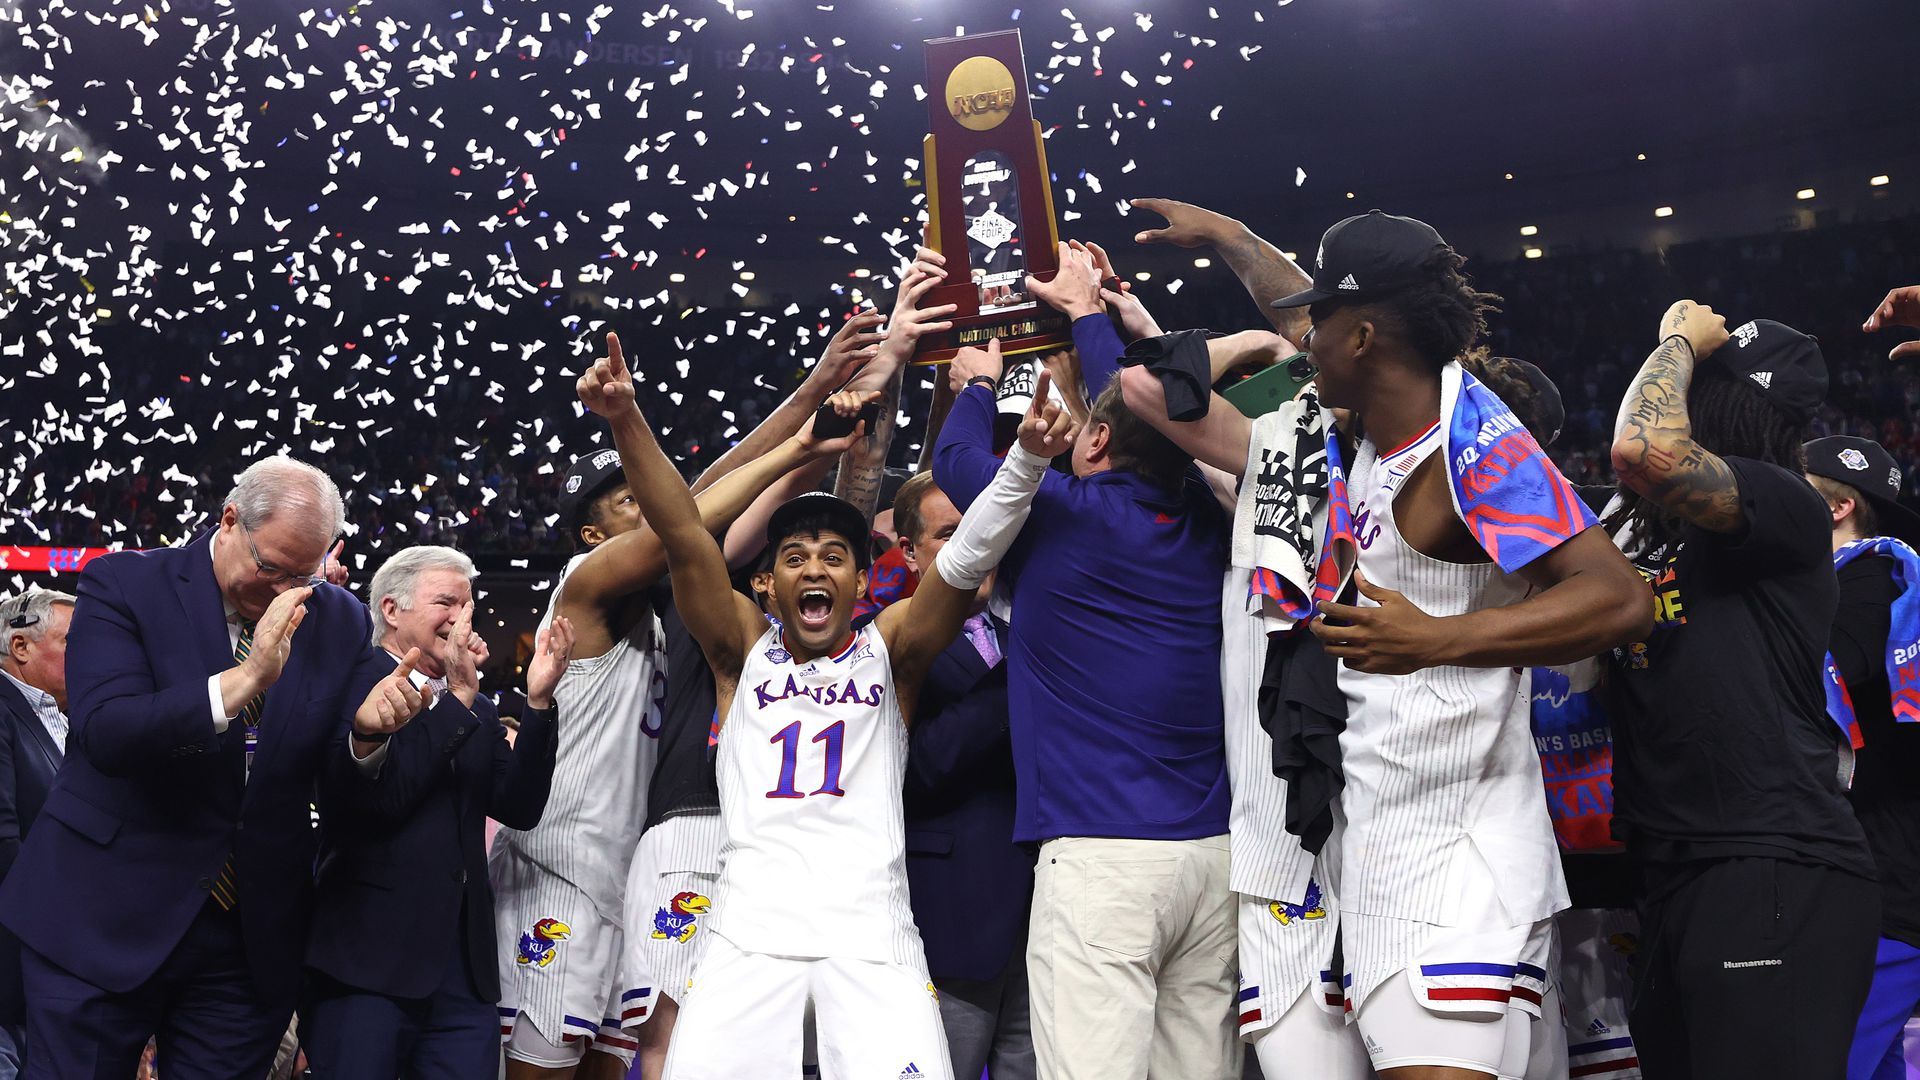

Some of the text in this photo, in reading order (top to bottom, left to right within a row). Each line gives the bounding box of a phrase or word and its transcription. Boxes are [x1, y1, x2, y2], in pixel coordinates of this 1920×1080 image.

[959, 327, 1009, 343] NATIONAL
[1749, 373, 1771, 390] adidas
[754, 673, 885, 710] KANSAS
[765, 719, 846, 799] 11
[666, 916, 683, 929] KU
[528, 942, 543, 954] KU
[1723, 959, 1782, 969] Humanrace
